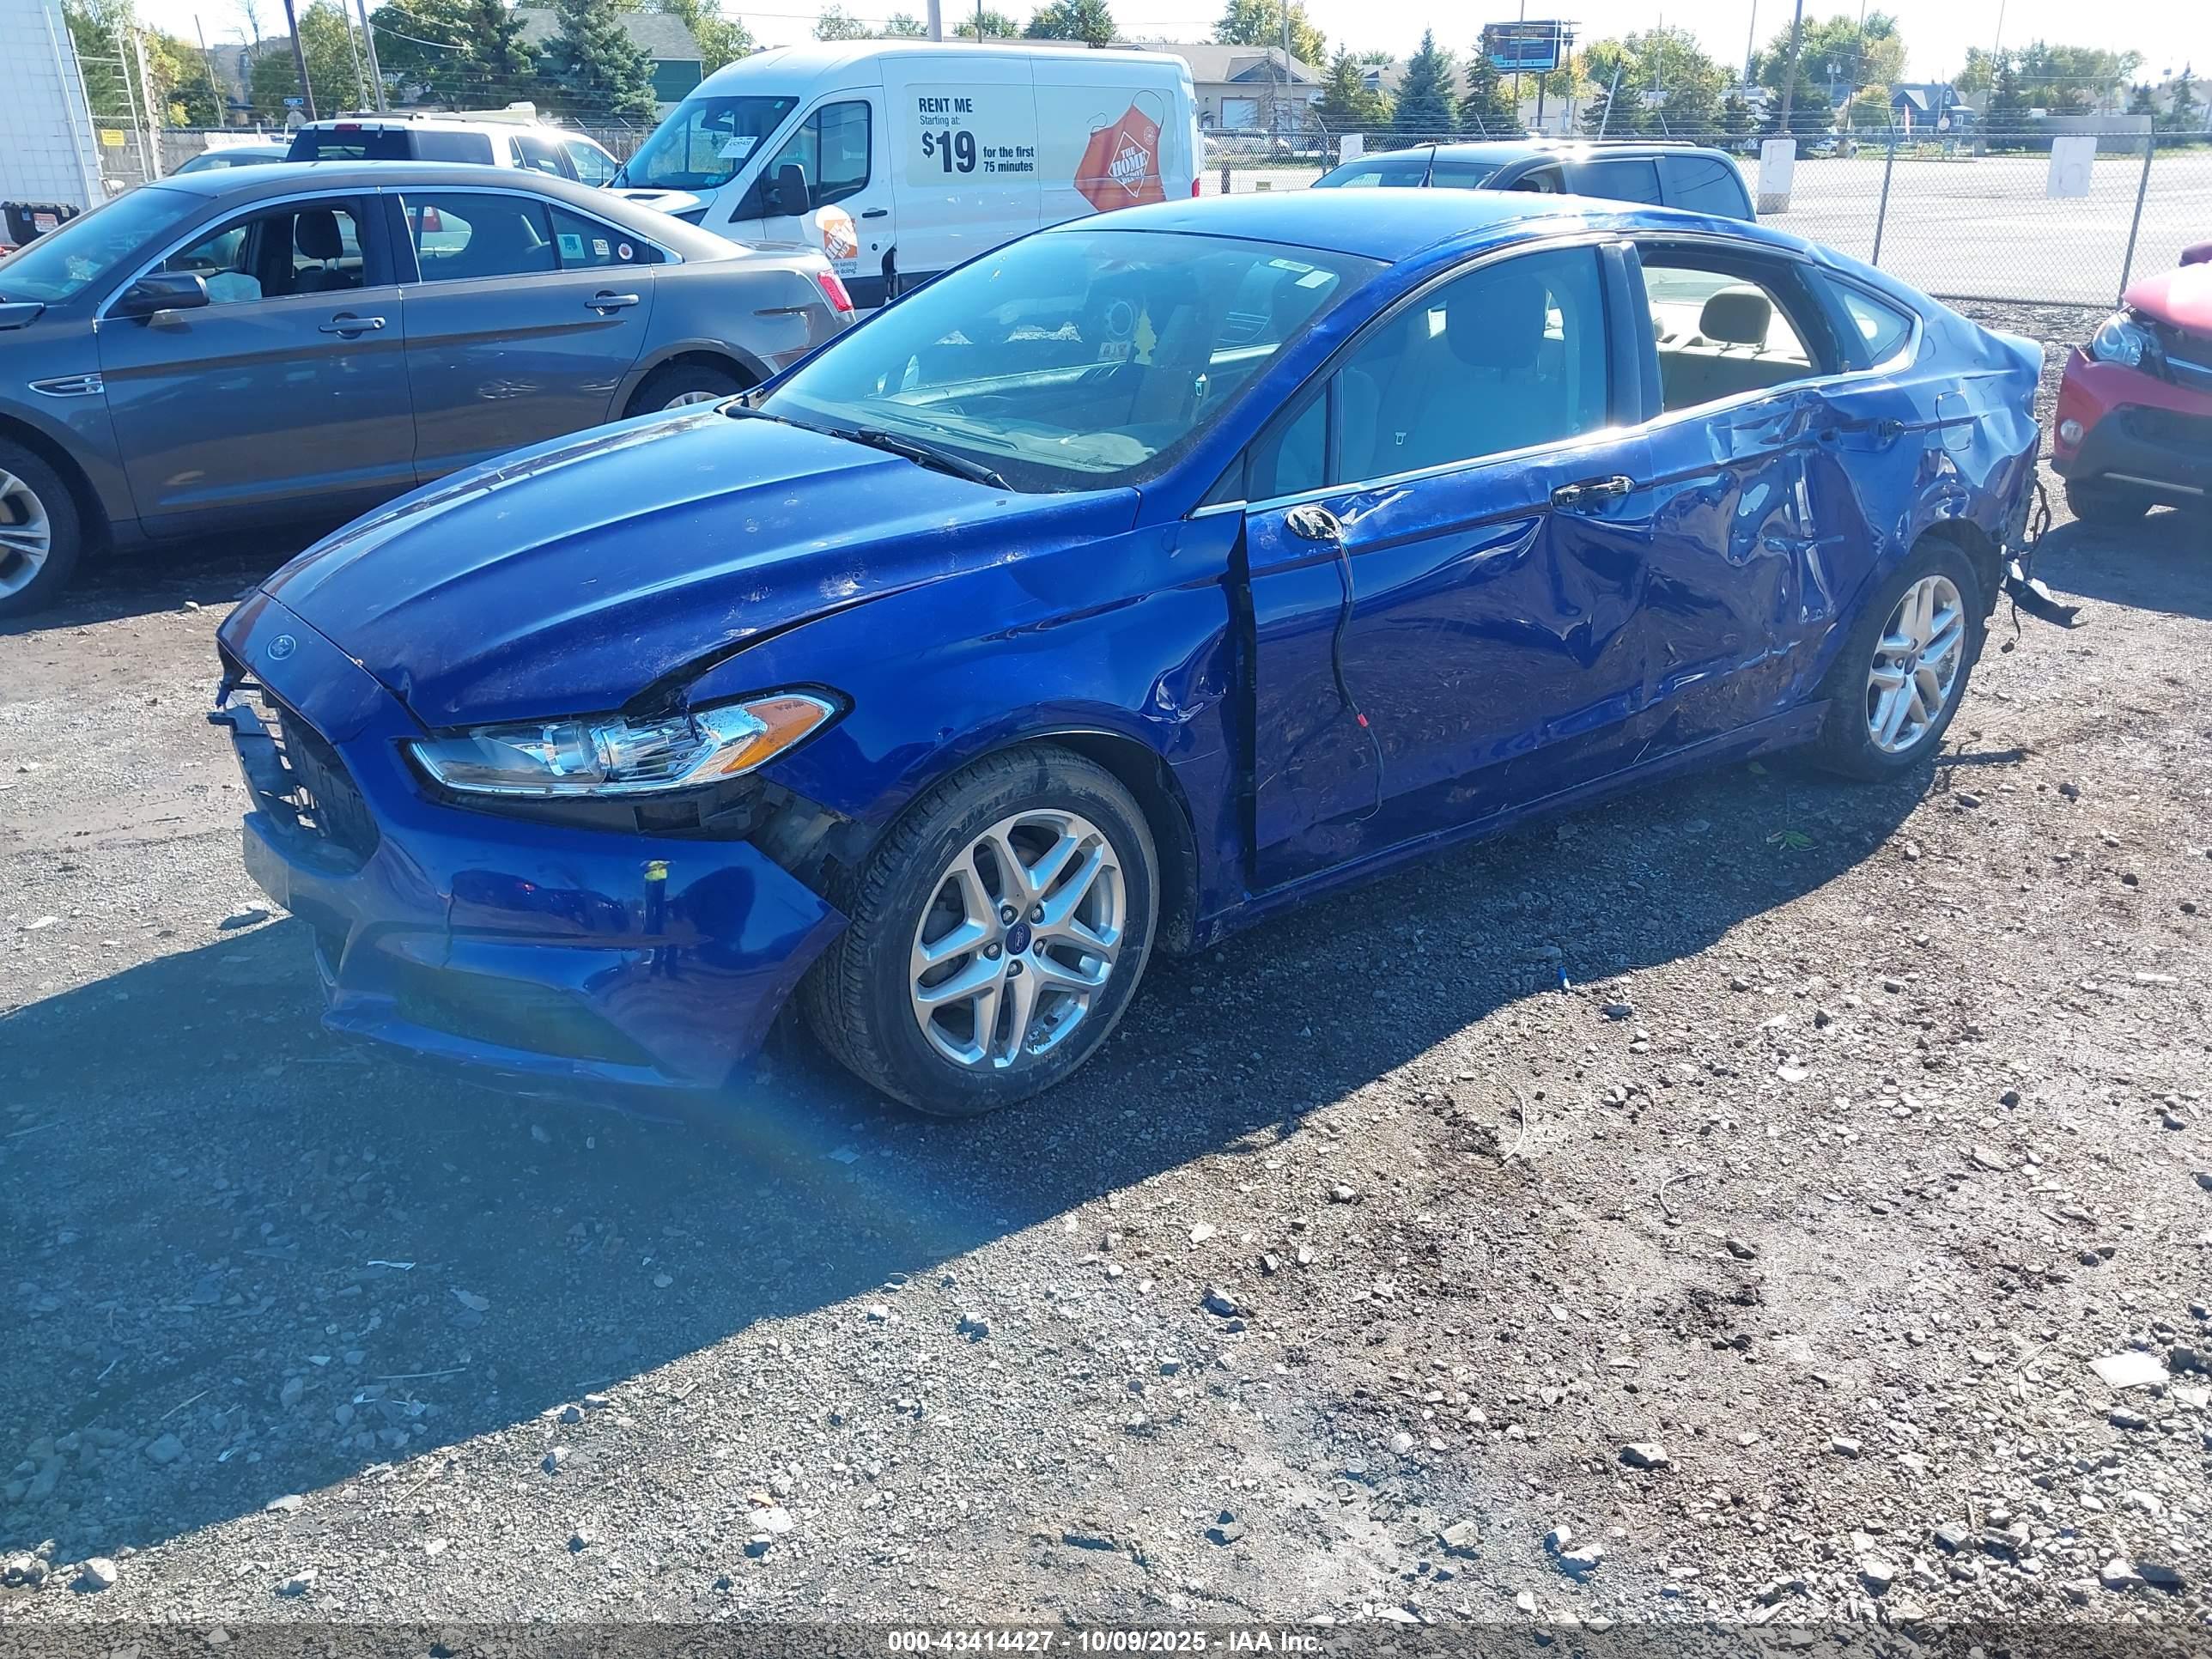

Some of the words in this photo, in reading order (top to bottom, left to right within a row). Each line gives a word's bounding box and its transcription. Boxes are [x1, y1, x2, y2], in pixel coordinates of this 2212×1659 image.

[918, 97, 950, 113] RENT
[954, 97, 973, 113] ME
[920, 115, 950, 127] Starting
[951, 115, 961, 125] at:
[921, 130, 976, 173] $19
[982, 146, 997, 158] for
[999, 146, 1013, 158] the
[1016, 145, 1035, 157] first
[1120, 145, 1136, 159] THE
[983, 161, 995, 173] 75
[998, 160, 1034, 173] minutes
[1111, 150, 1147, 178] HOME
